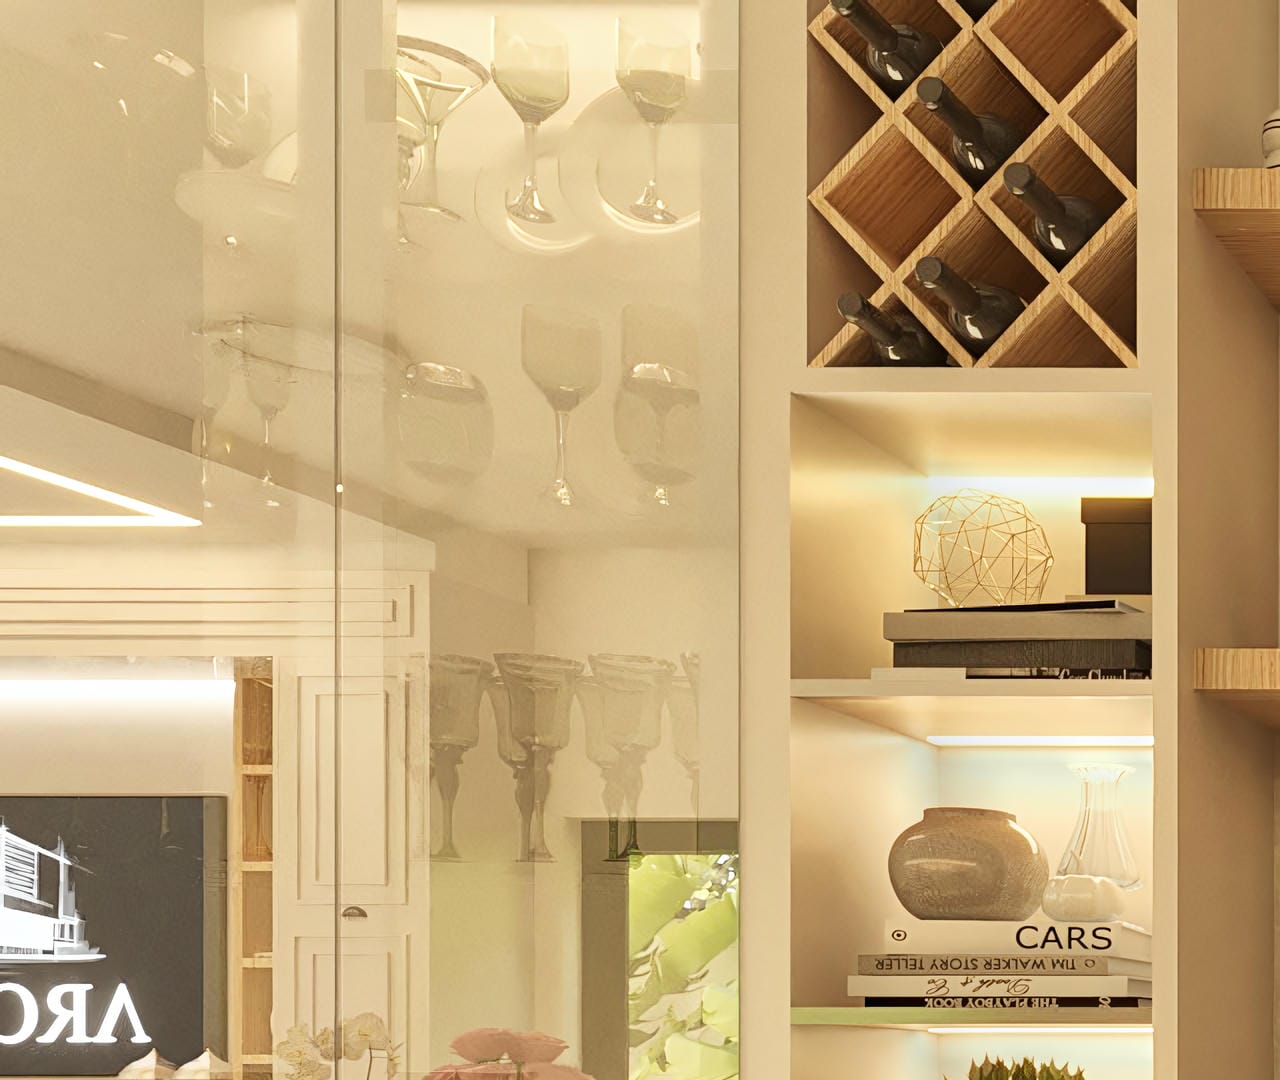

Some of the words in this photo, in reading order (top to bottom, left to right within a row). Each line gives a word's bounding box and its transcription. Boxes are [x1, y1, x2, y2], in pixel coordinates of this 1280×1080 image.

[1015, 925, 1113, 950] CARS
[874, 957, 925, 971] TELLER
[929, 957, 979, 971] STORY
[983, 957, 1046, 971] WALKER
[1050, 957, 1077, 971] TIM
[966, 997, 1029, 1009] PLAYBOY
[1030, 997, 1059, 1009] THE
